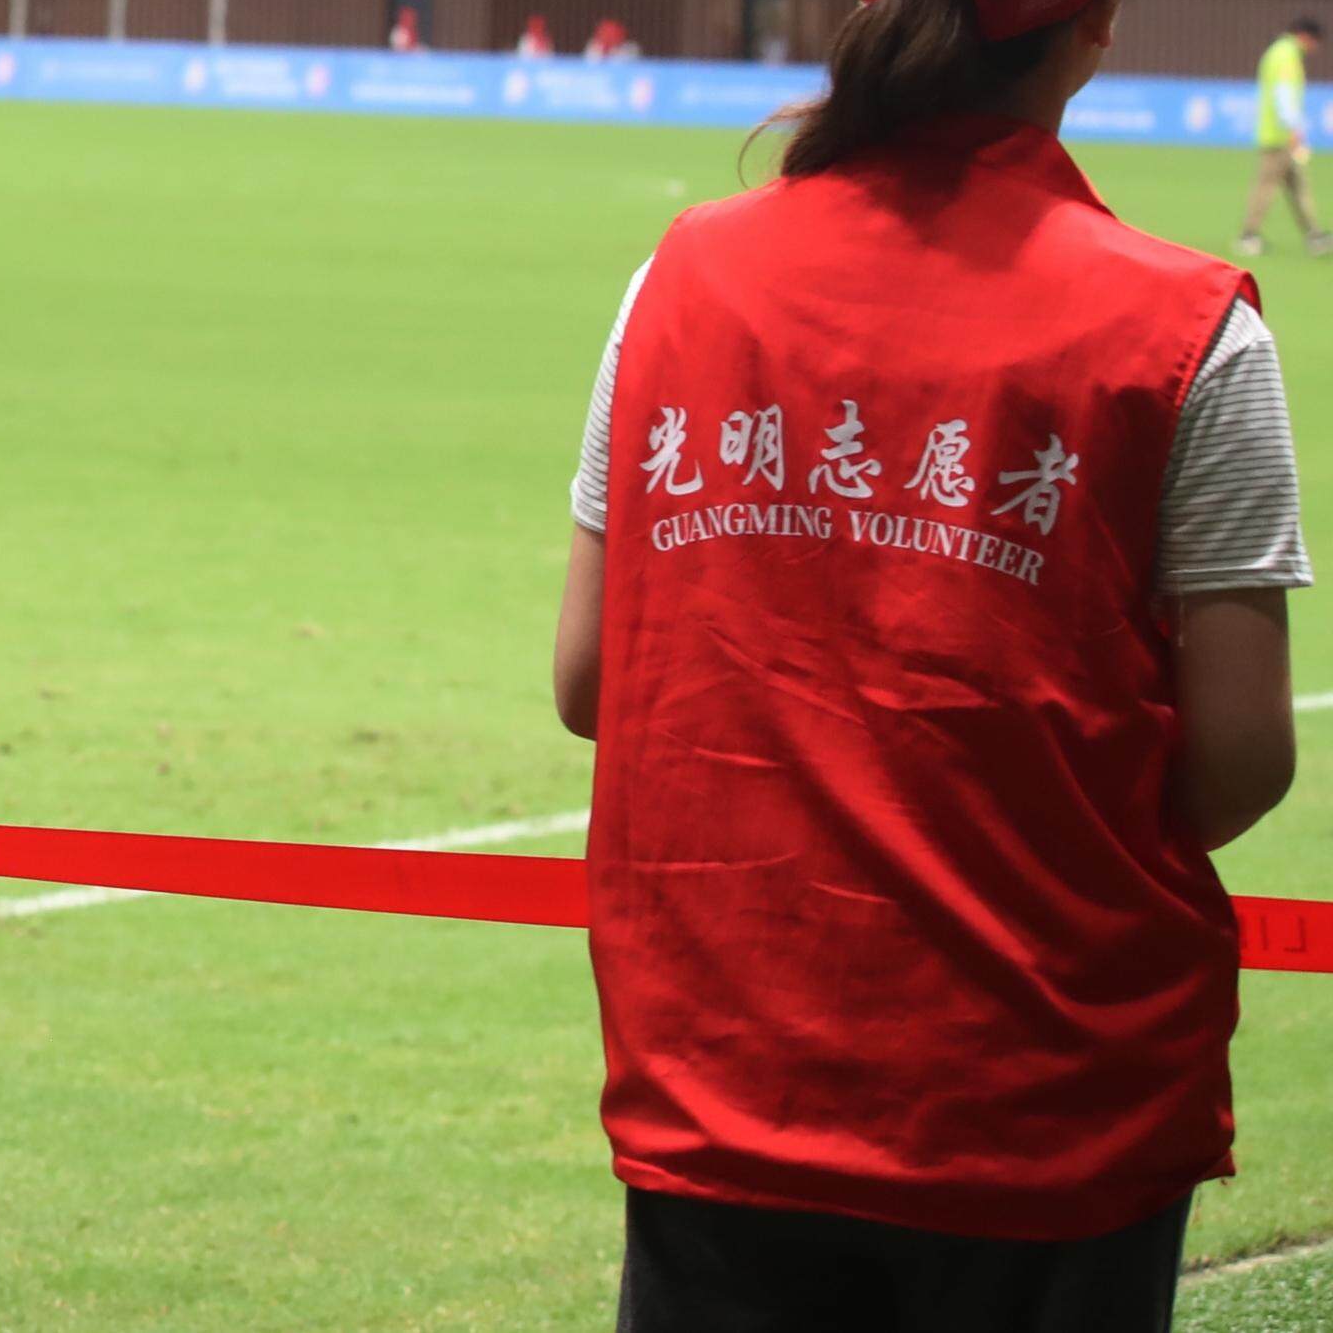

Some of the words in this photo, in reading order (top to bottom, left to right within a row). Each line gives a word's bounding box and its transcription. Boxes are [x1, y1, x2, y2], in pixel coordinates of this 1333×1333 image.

[639, 399, 1080, 536] 光明志愿者
[651, 503, 833, 551] GUANGMING
[849, 510, 1045, 585] VOLUNTEER
